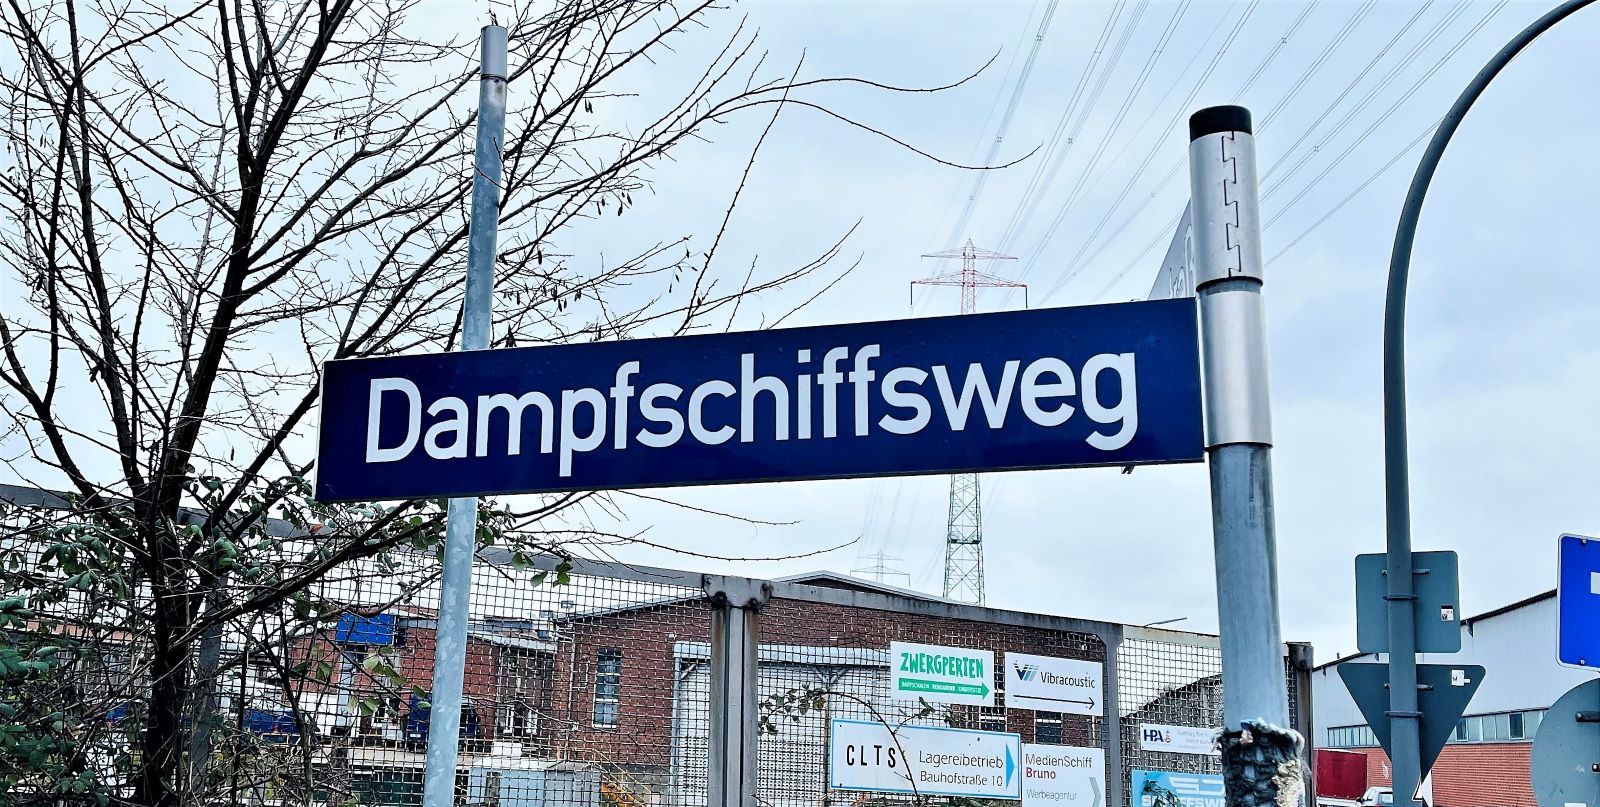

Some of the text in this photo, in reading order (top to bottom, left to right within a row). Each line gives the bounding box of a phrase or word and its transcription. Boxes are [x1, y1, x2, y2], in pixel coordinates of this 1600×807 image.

[365, 344, 1139, 477] Dampfschiffsweg
[900, 652, 984, 679] ZWERGPERTEN
[1040, 671, 1096, 688] Vibracoustic
[1143, 729, 1164, 742] HPA
[846, 744, 896, 768] CLTS
[919, 750, 1004, 769] Lagereibetrieb
[1025, 753, 1092, 768] MedienSchiff
[920, 770, 1003, 787] Bauhofstraße 10
[1026, 767, 1057, 779] Bruno
[1026, 789, 1078, 802] Werbeagentur
